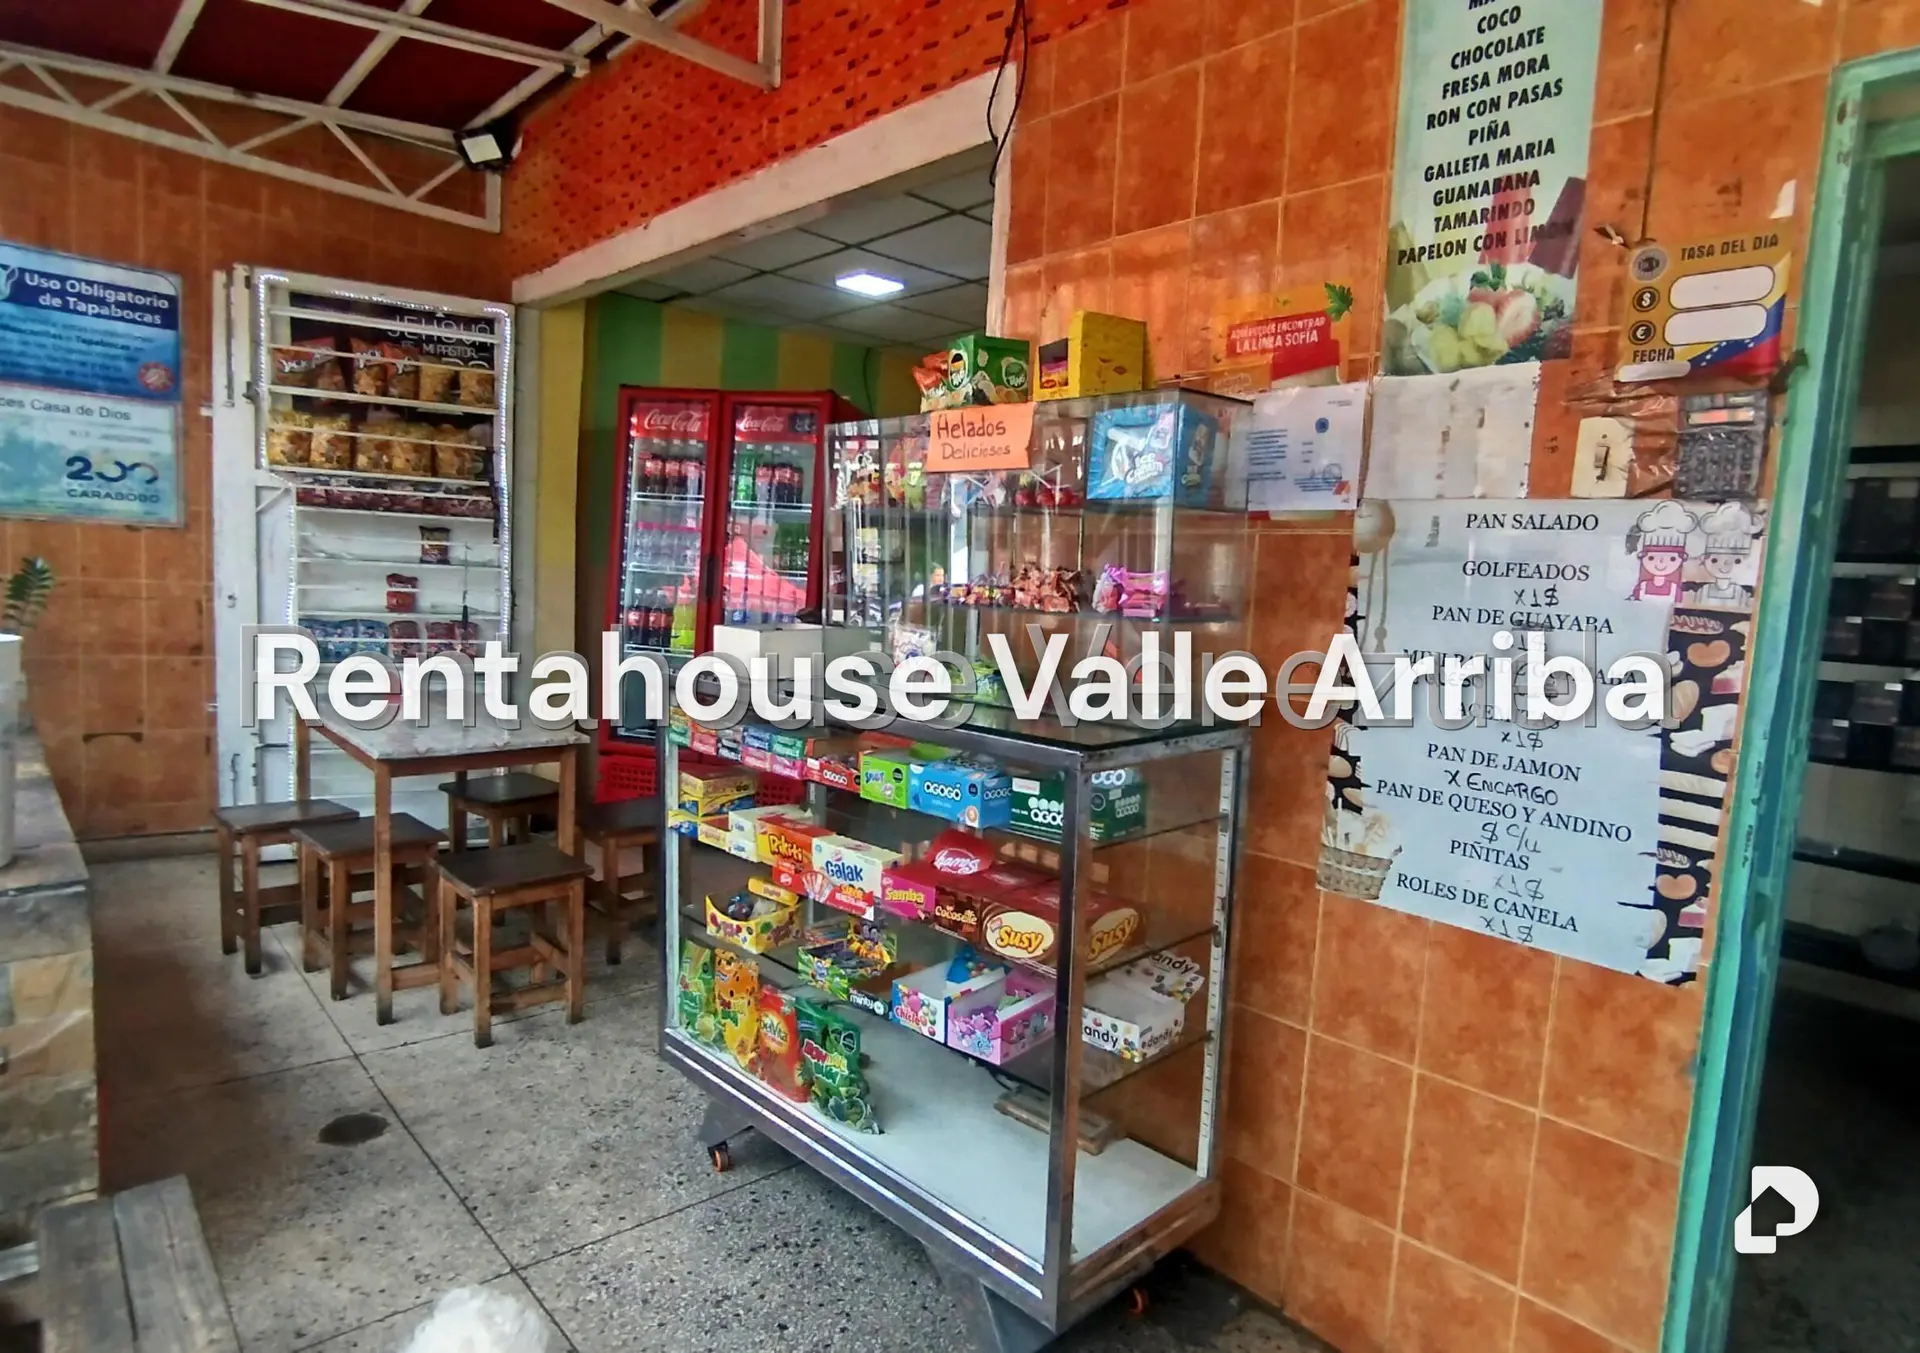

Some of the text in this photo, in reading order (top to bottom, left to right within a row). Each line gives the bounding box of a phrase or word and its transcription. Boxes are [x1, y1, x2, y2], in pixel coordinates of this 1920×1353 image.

[1477, 5, 1521, 34] COCO
[1451, 26, 1546, 70] CHOCOLATE
[1441, 54, 1550, 100] FRESA MORA
[1426, 78, 1564, 130] RON CON PASAS
[1469, 120, 1511, 146] PIÑA
[1424, 138, 1555, 182] GALLETA MARIA
[1433, 169, 1541, 207] GUANABANA
[1434, 199, 1536, 233] TAMARINDO
[1398, 238, 1467, 266] PAPELON
[1473, 231, 1506, 252] CON
[1680, 234, 1779, 261] TASA DEL DIA
[24, 272, 170, 310] Uso Obligatorio
[38, 293, 162, 325] de Tapabocas
[1632, 347, 1676, 363] FECHA
[31, 398, 71, 414] Casa
[76, 405, 95, 417] de
[99, 406, 132, 421] Dios
[937, 413, 1007, 440] Helados
[67, 488, 162, 504] CARABOBO
[1465, 513, 1600, 531] PAN SALADO
[1462, 560, 1591, 581] GOLFEADOS
[1432, 605, 1614, 634] PAN DE GUAYABA
[1427, 742, 1582, 782] PAN DE JAMON
[1466, 772, 1559, 807] ENCARGO
[1376, 779, 1633, 843] PAN DE QUESO Y ANDINO
[1450, 838, 1530, 871] PIÑITAS
[825, 860, 864, 882] Galak
[885, 887, 925, 904] Samba
[1396, 872, 1579, 932] ROLES DE CANELA
[996, 925, 1044, 954] Susy
[1087, 915, 1135, 962] Susy
